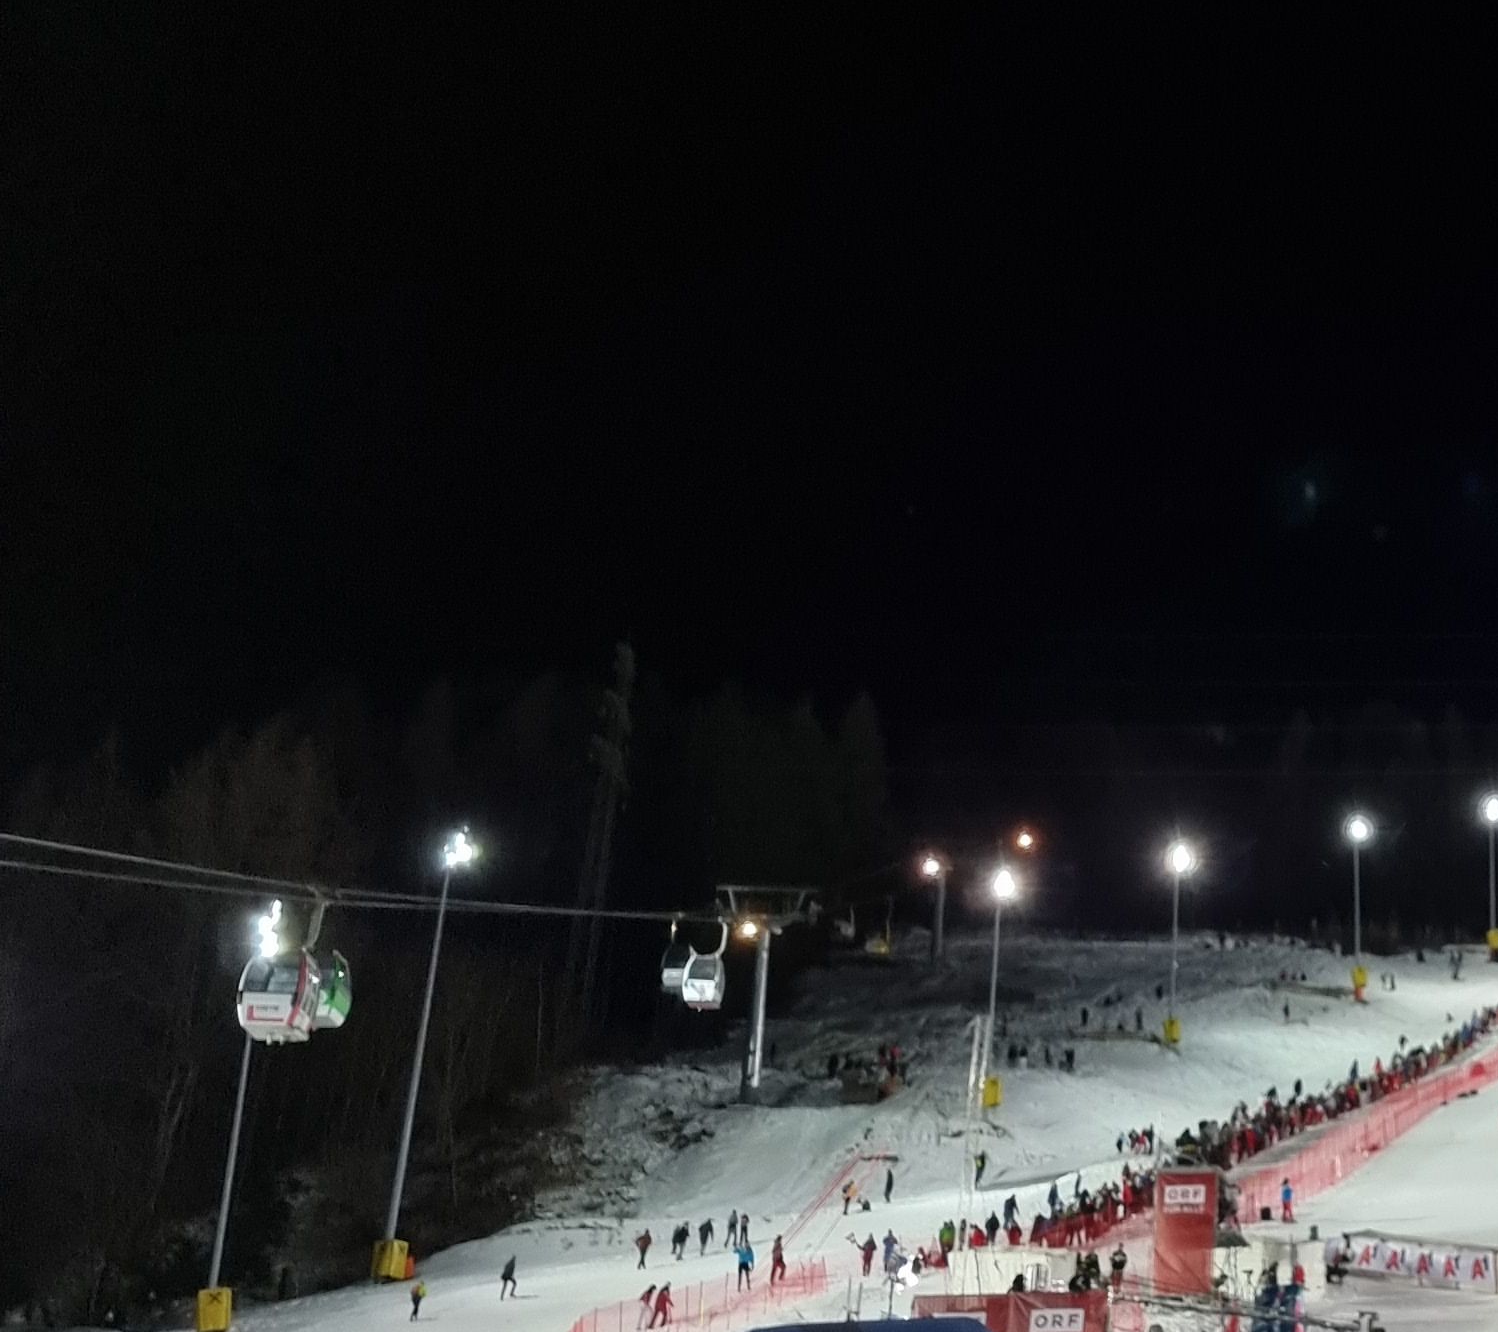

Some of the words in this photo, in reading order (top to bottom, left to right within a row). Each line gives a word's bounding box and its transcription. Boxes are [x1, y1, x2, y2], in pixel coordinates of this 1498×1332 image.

[1358, 1244, 1379, 1266] A1
[1385, 1247, 1406, 1270] A1
[1416, 1251, 1433, 1274] A1
[1443, 1254, 1460, 1278] A1
[1471, 1255, 1489, 1280] A1
[1035, 1314, 1080, 1329] ORF
